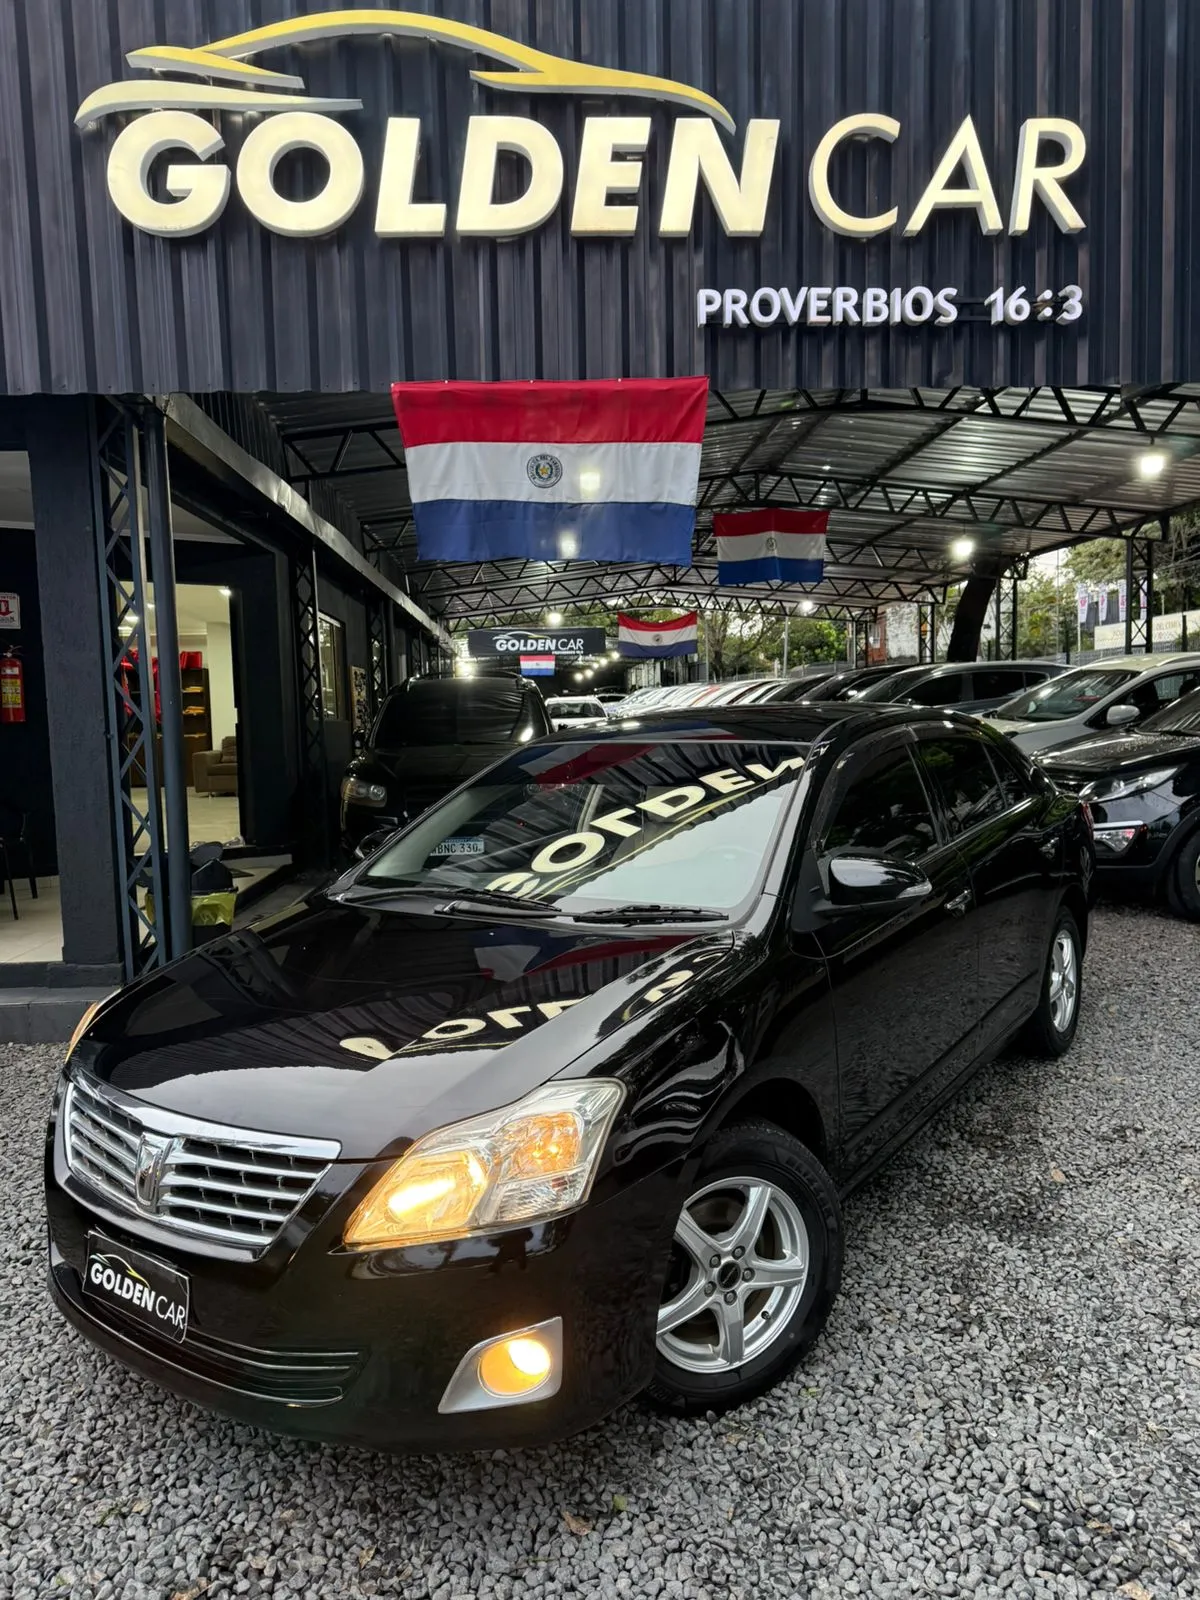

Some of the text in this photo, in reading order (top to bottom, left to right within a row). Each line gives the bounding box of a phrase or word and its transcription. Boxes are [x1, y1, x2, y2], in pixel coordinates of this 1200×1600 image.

[107, 112, 1087, 237] GOLDEN CAR
[697, 284, 1083, 328] PROVERBIOS 16:3
[495, 638, 584, 651] GOLDEN CAR
[459, 843, 478, 853] 330
[90, 1262, 186, 1330] GOLDEN CAR
